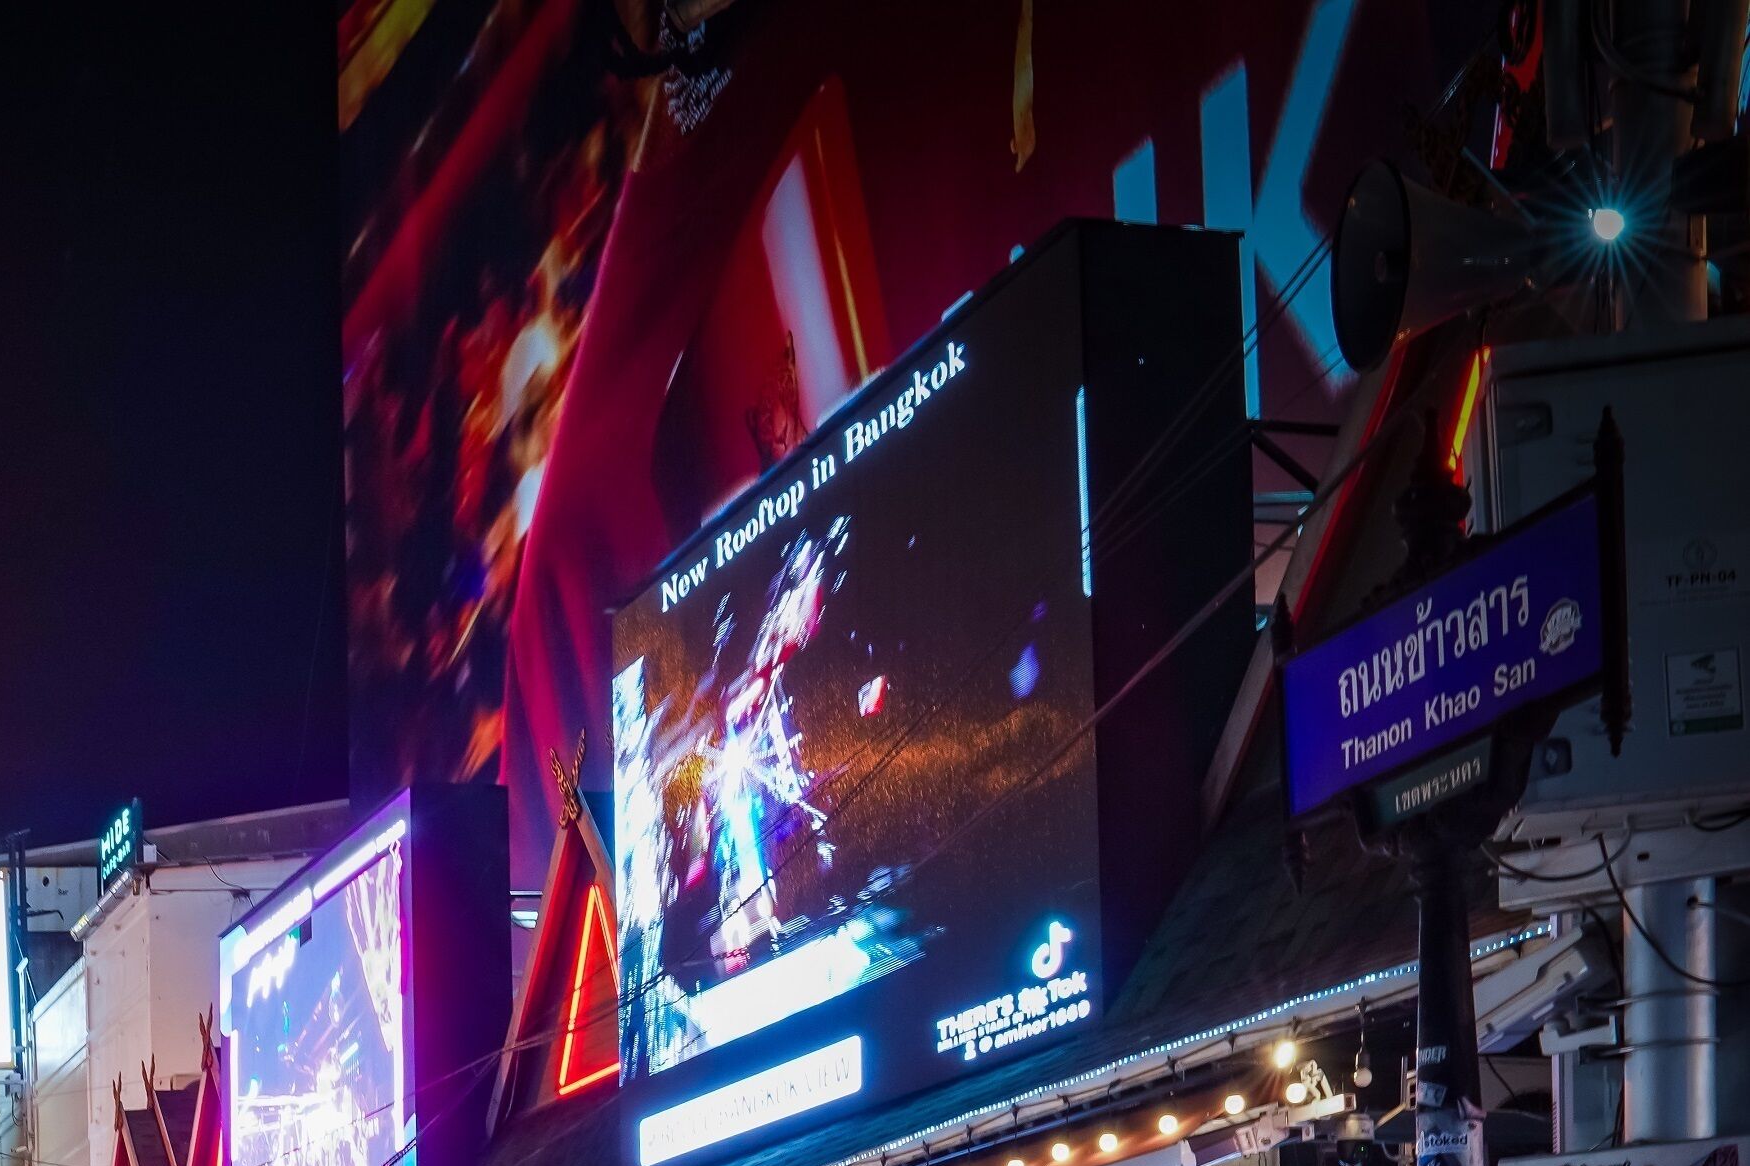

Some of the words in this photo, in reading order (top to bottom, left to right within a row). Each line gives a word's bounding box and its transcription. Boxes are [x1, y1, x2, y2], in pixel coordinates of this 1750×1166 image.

[660, 557, 708, 613] New
[714, 479, 805, 569] Rooftop
[812, 454, 836, 490] in
[843, 341, 967, 464] Bangkok
[1338, 575, 1529, 719] ถนนข้าวสาร
[1341, 718, 1412, 770] Thanon
[1424, 685, 1481, 730] Khao
[1493, 657, 1536, 698] San
[101, 808, 130, 861] HIDE
[1395, 756, 1481, 815] เขตพระนคร
